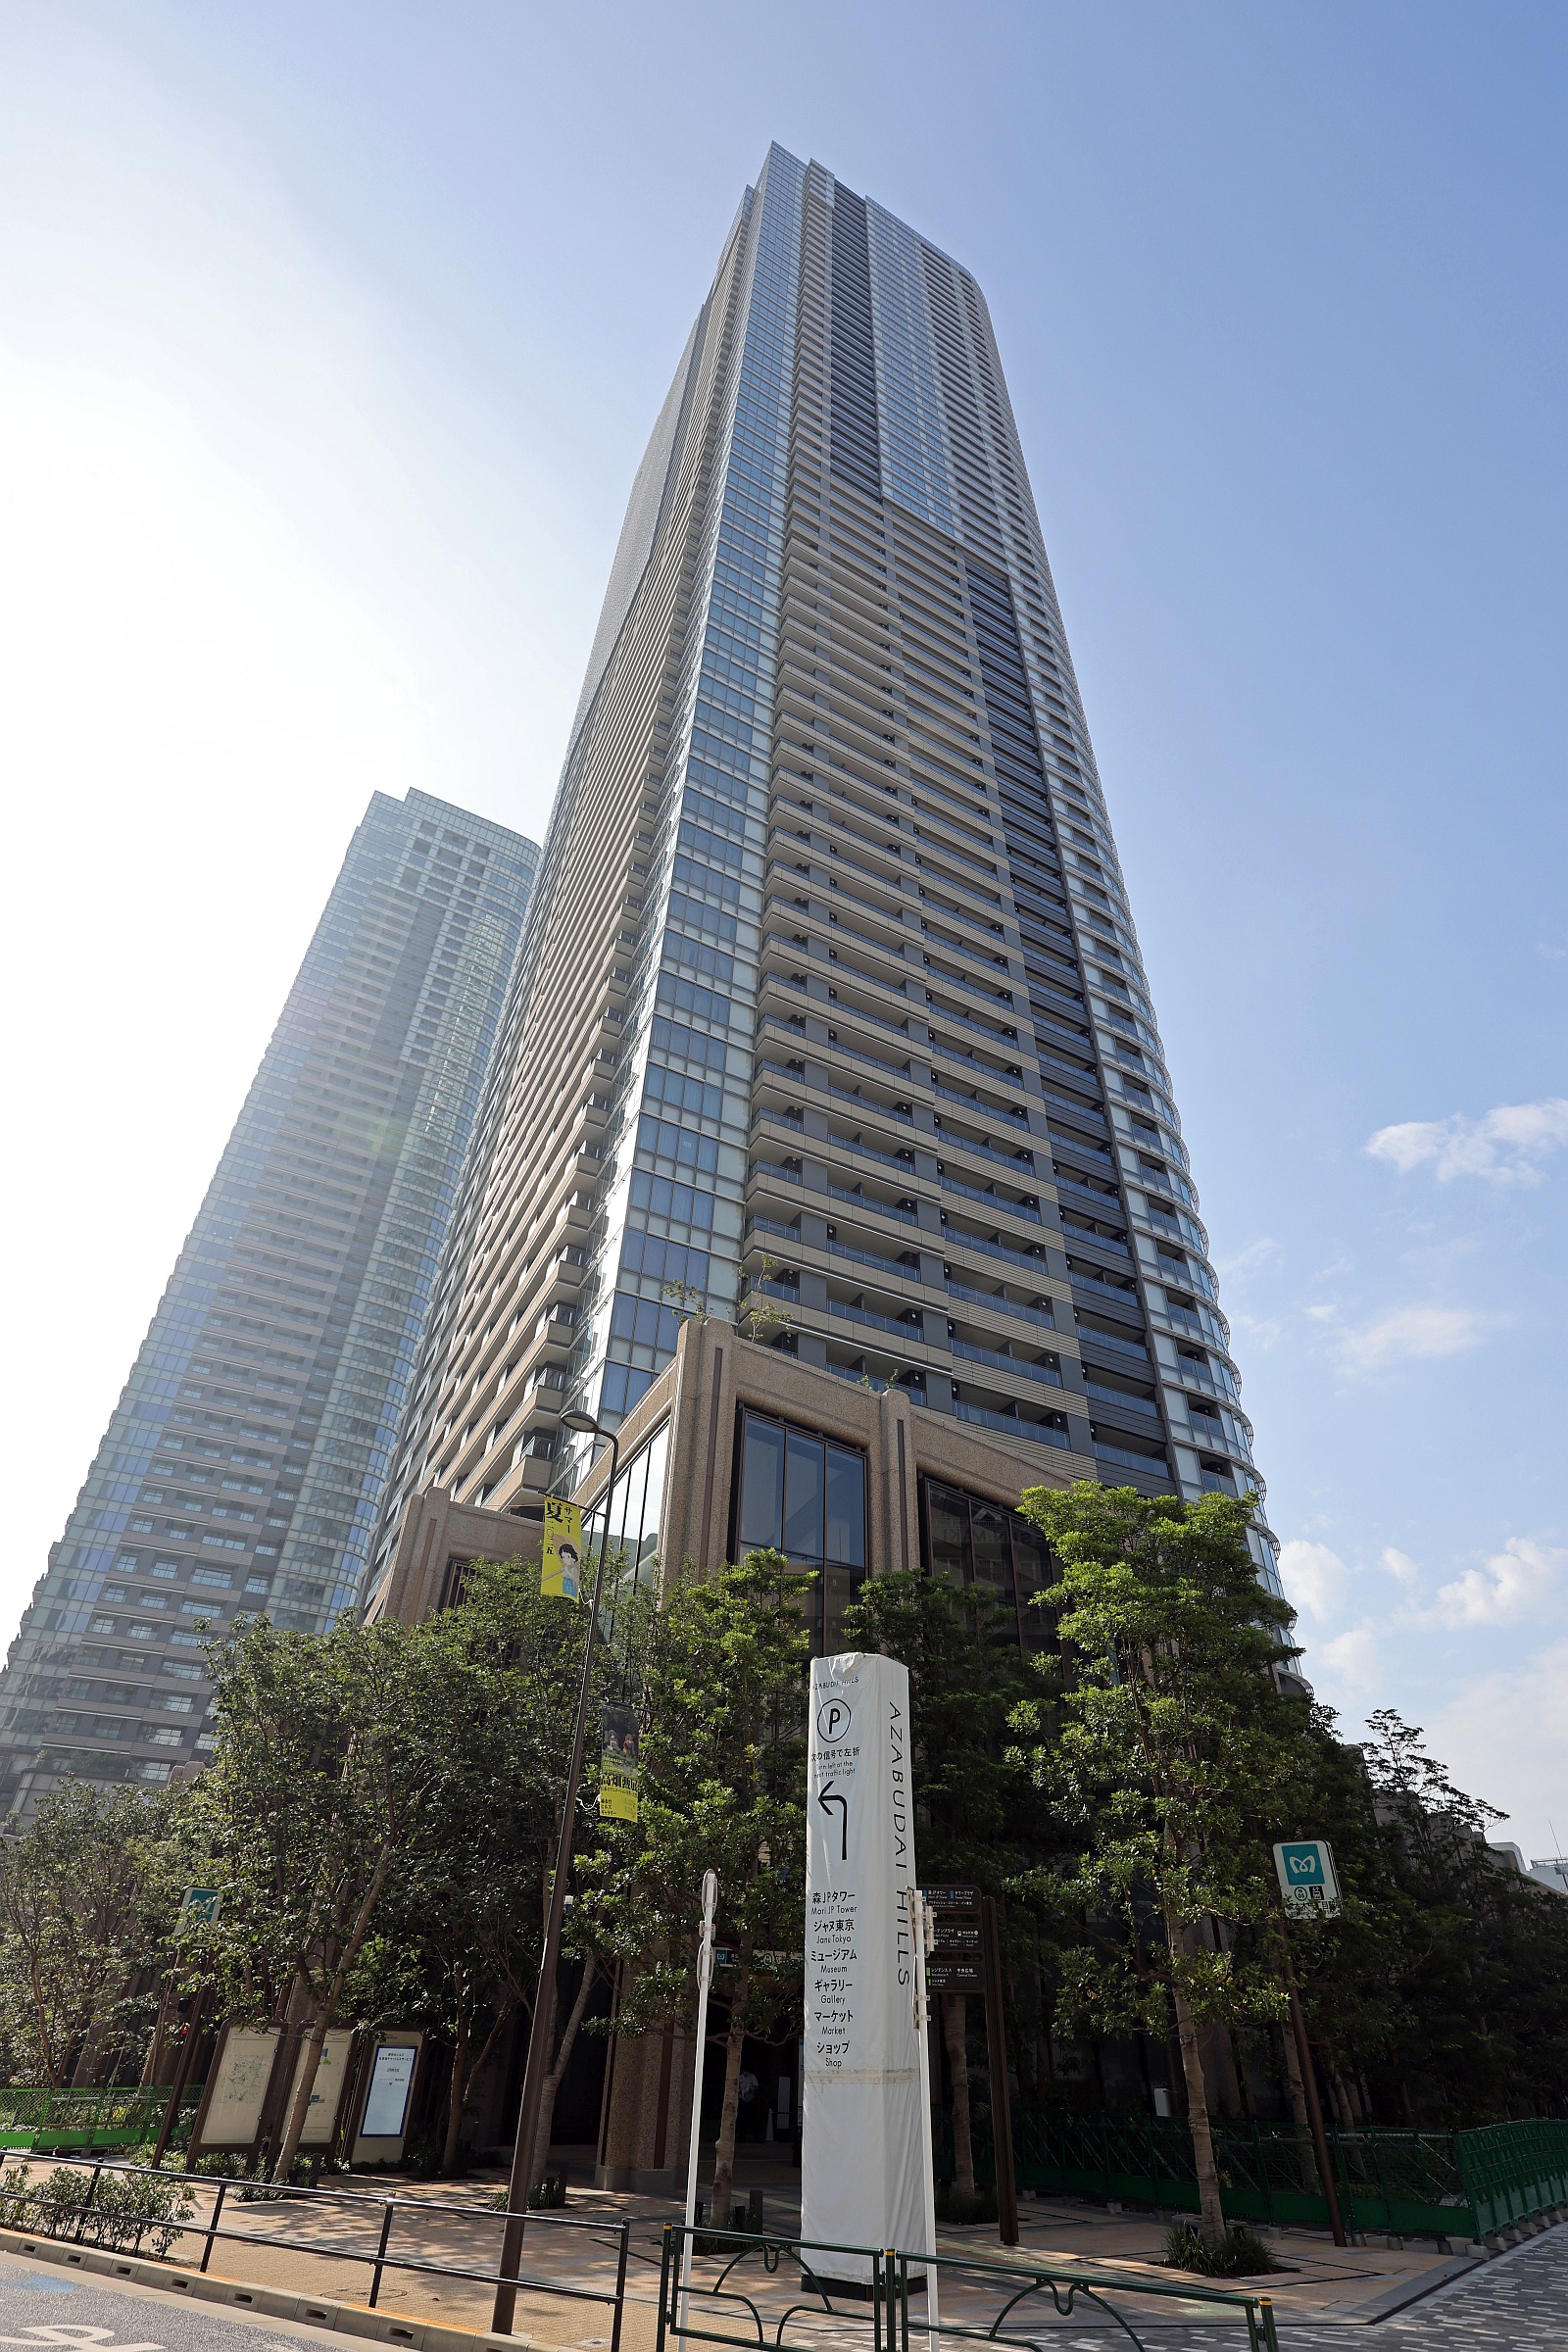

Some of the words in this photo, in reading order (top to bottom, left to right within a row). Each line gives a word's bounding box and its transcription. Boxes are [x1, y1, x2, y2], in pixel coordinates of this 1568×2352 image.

[546, 1502, 563, 1523] 夏
[829, 1708, 841, 1735] P
[811, 1746, 859, 1762] 次の信号で左折
[889, 1701, 907, 1869] AZABUDAI
[812, 1890, 856, 1904] 森JPタワー
[811, 1906, 826, 1915] Mori
[828, 1905, 834, 1914] JP
[837, 1904, 858, 1913] Tower
[814, 1919, 855, 1933] ジャヌ東京
[816, 1935, 831, 1944] Janu
[832, 1934, 852, 1944] Tokyo
[897, 1890, 909, 1985] HILLS
[811, 1947, 858, 1962] ミュージアム
[820, 1964, 848, 1974] Museum
[814, 1979, 853, 1992] ギャラリー
[821, 1994, 846, 2005] Gallery
[814, 2009, 854, 2023] マーケット
[822, 2026, 846, 2034] Market
[817, 2040, 851, 2055] ショップ
[825, 2057, 843, 2069] Shop
